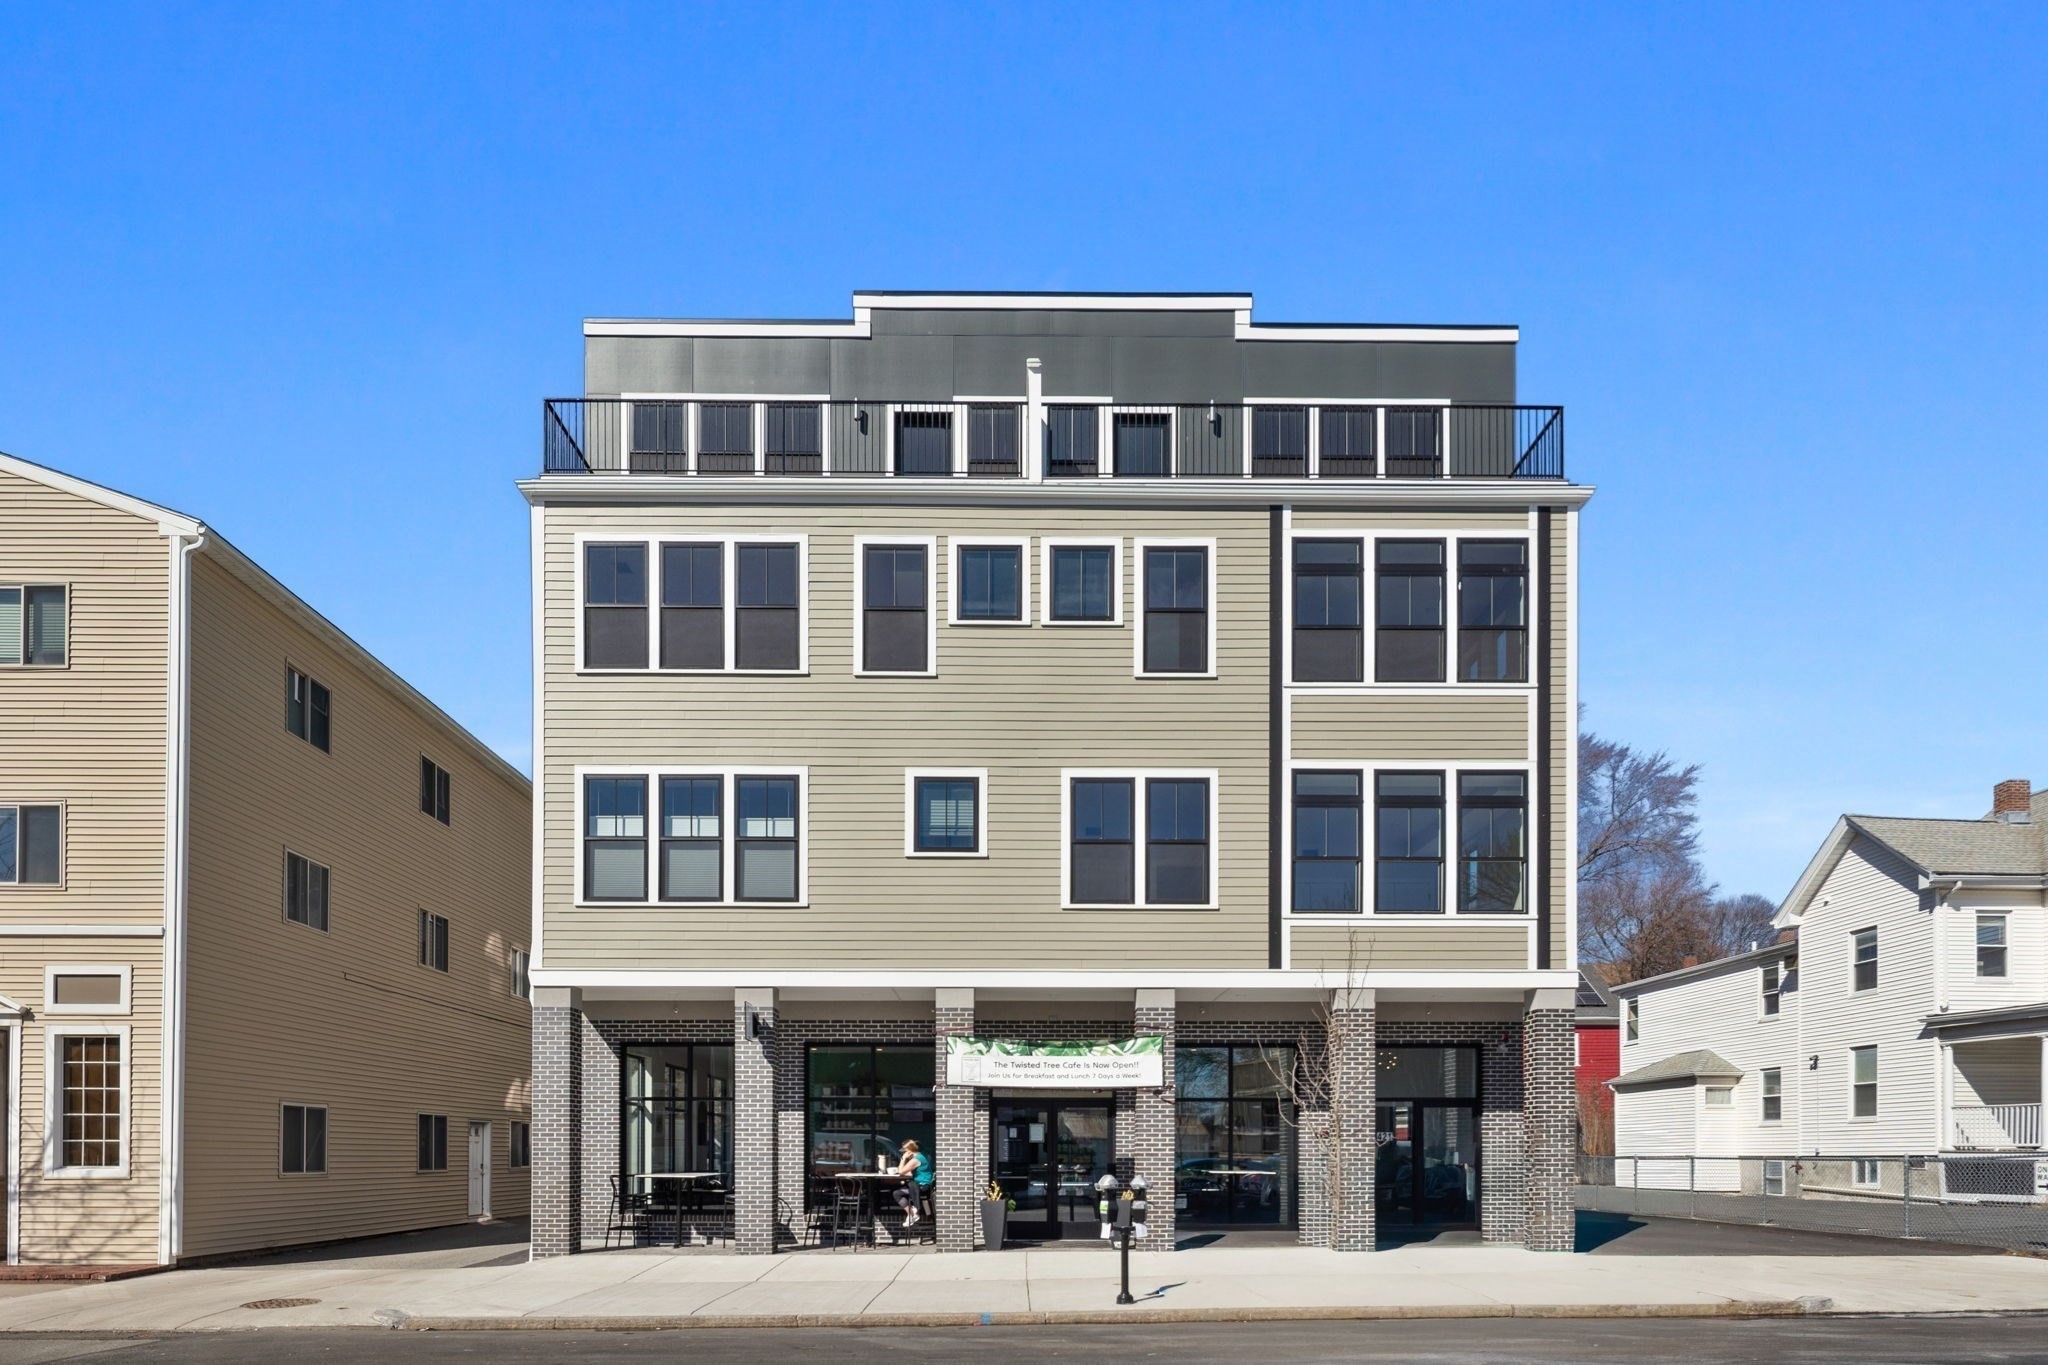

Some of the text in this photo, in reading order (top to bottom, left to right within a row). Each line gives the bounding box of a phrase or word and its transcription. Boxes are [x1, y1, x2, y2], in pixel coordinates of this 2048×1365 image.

[994, 1061, 1139, 1070] The Twisted Tree Cafe Is Now Open!!
